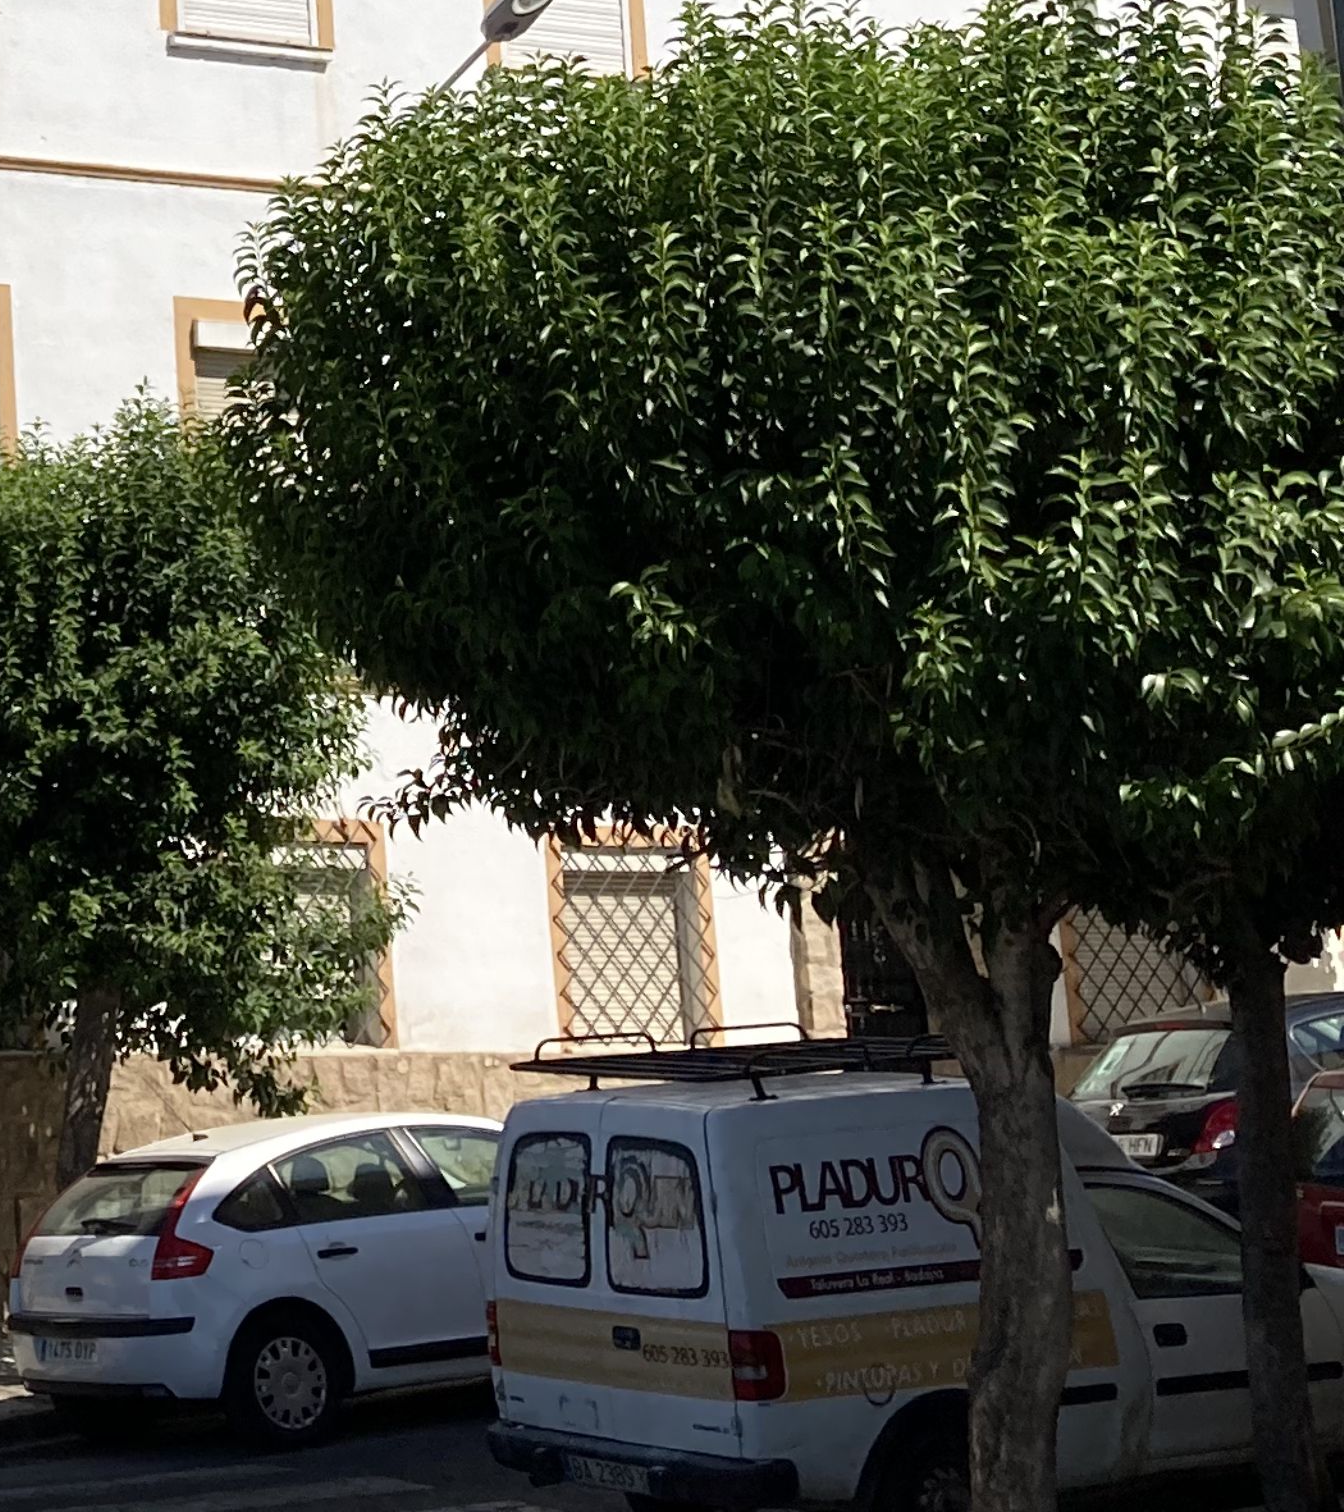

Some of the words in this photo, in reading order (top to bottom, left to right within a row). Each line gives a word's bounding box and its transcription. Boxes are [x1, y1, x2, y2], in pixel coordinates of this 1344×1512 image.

[809, 1219, 840, 1240] 605
[843, 1215, 874, 1236] 283
[879, 1212, 909, 1233] 393
[642, 1343, 667, 1363] 605
[670, 1346, 698, 1366] 283
[701, 1349, 729, 1369] 393
